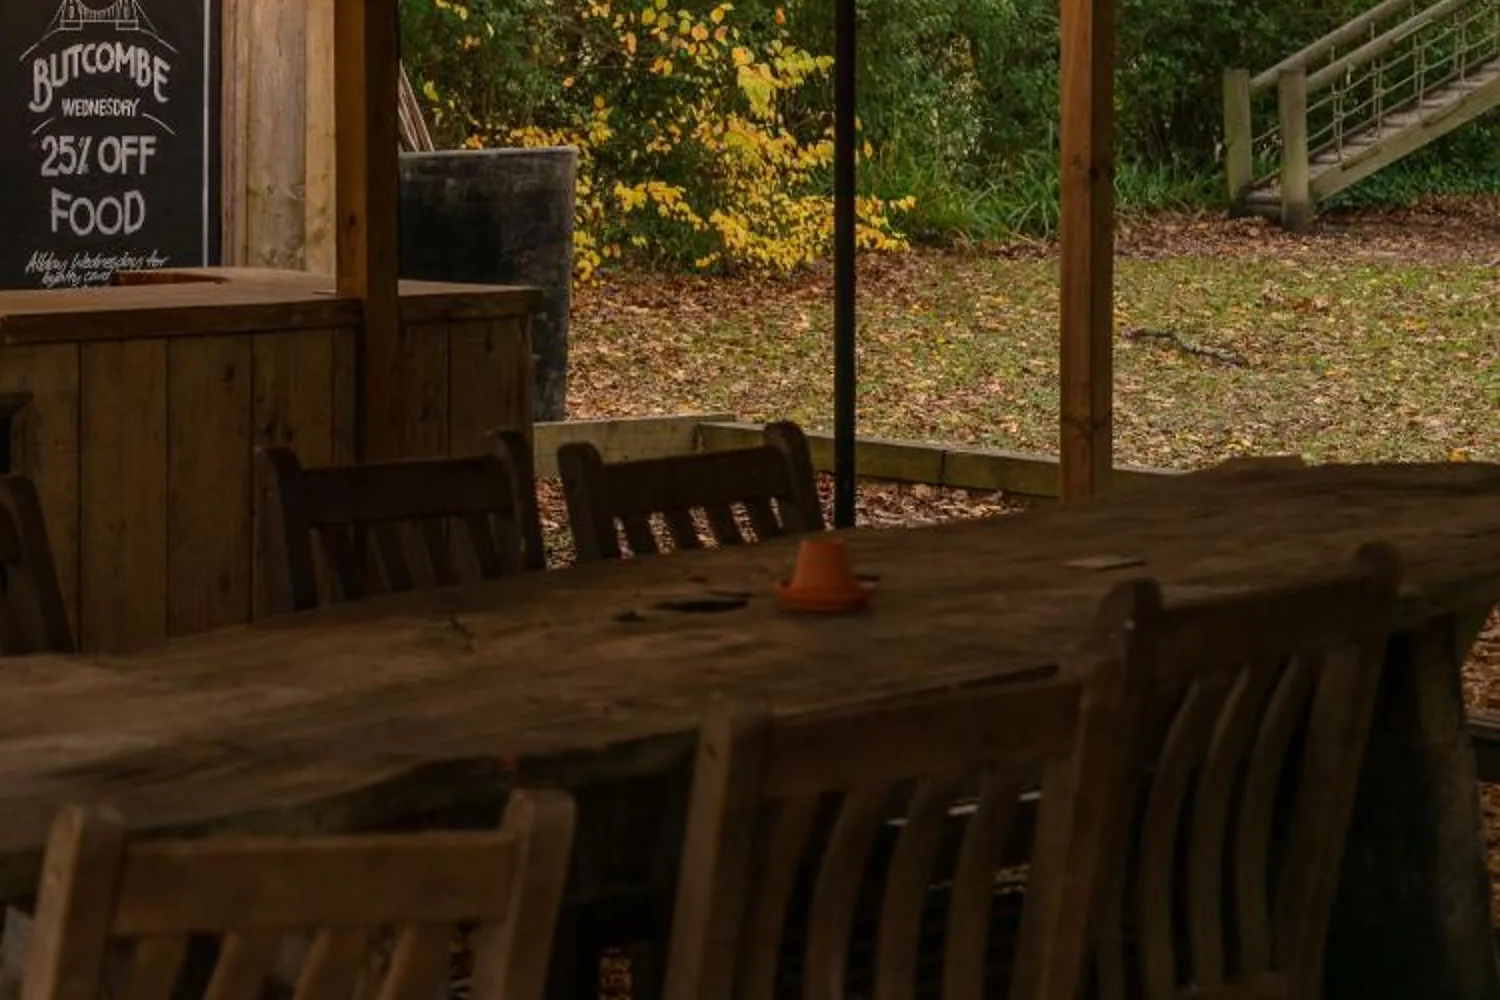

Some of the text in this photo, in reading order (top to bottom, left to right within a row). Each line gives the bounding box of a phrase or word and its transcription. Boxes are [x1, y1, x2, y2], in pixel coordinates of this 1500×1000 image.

[28, 41, 171, 112] BUTCOMBE
[61, 97, 141, 117] WEDNESDAY
[41, 135, 157, 177] 25% OFF
[51, 186, 146, 236] FOOD
